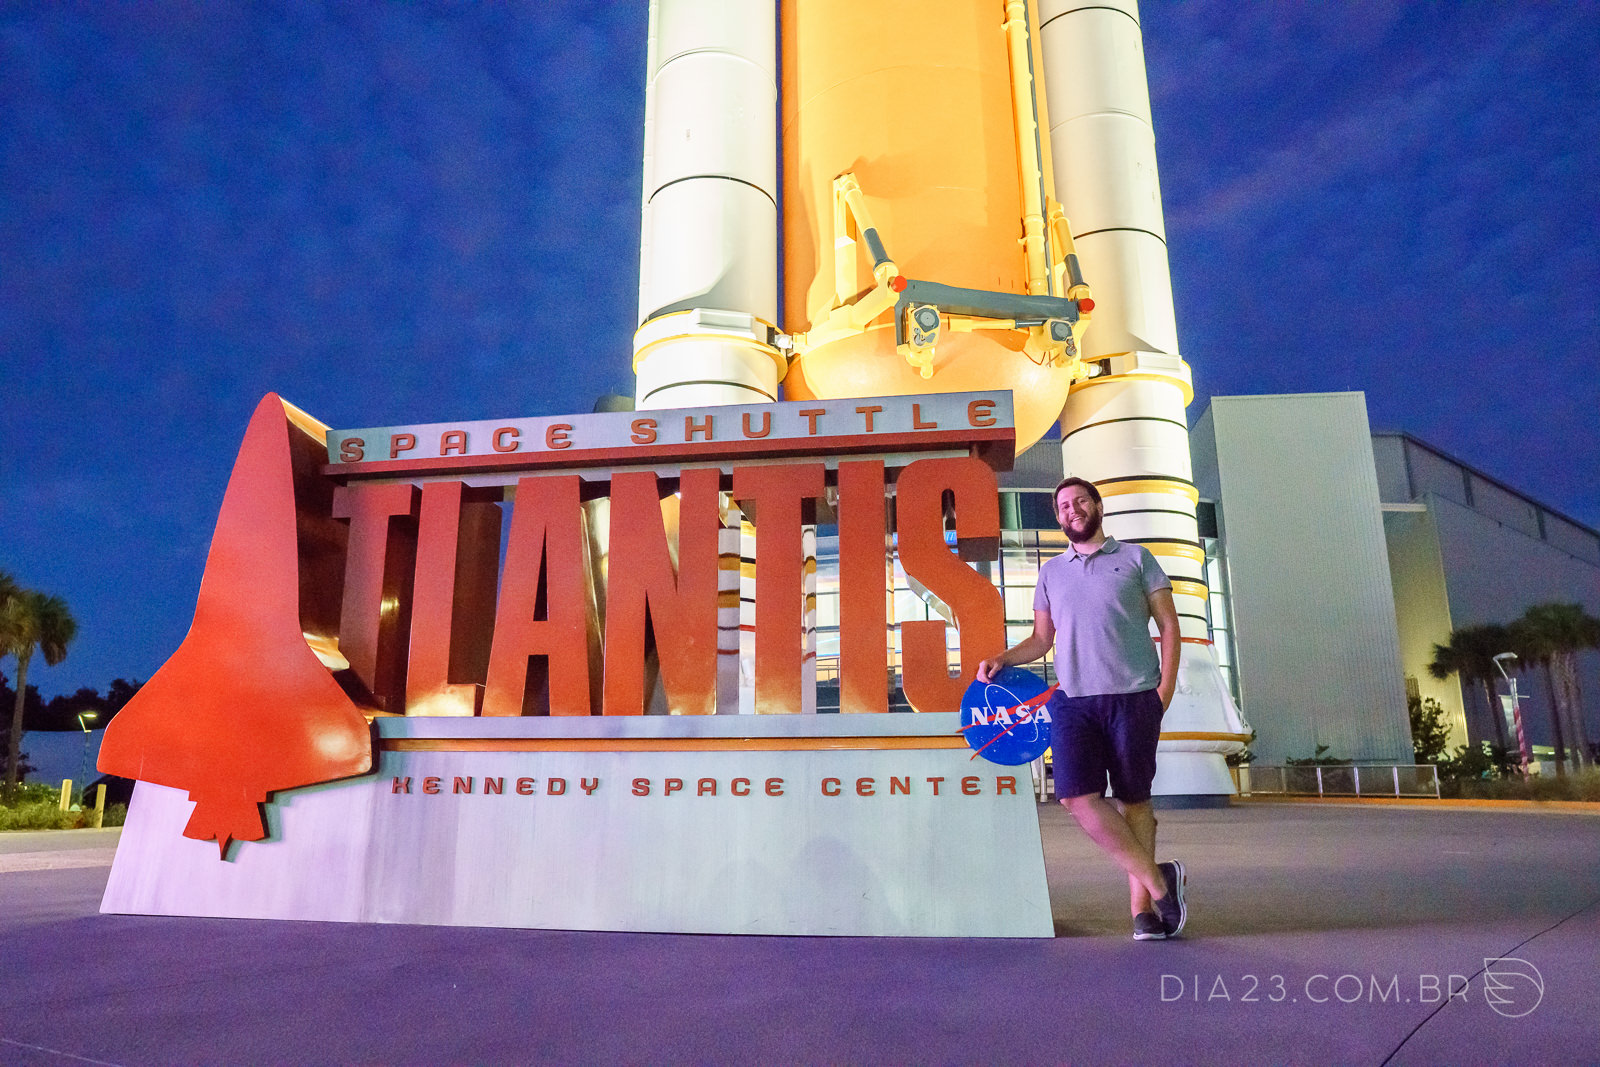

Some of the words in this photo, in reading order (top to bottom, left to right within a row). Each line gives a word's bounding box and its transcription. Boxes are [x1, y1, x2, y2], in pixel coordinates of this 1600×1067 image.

[340, 423, 574, 463] SPACE
[630, 399, 998, 444] SHUTTLE
[969, 704, 1053, 726] NASA
[391, 775, 599, 797] KENNEDY
[631, 776, 785, 797] SPACE
[821, 775, 1018, 797] CENTER
